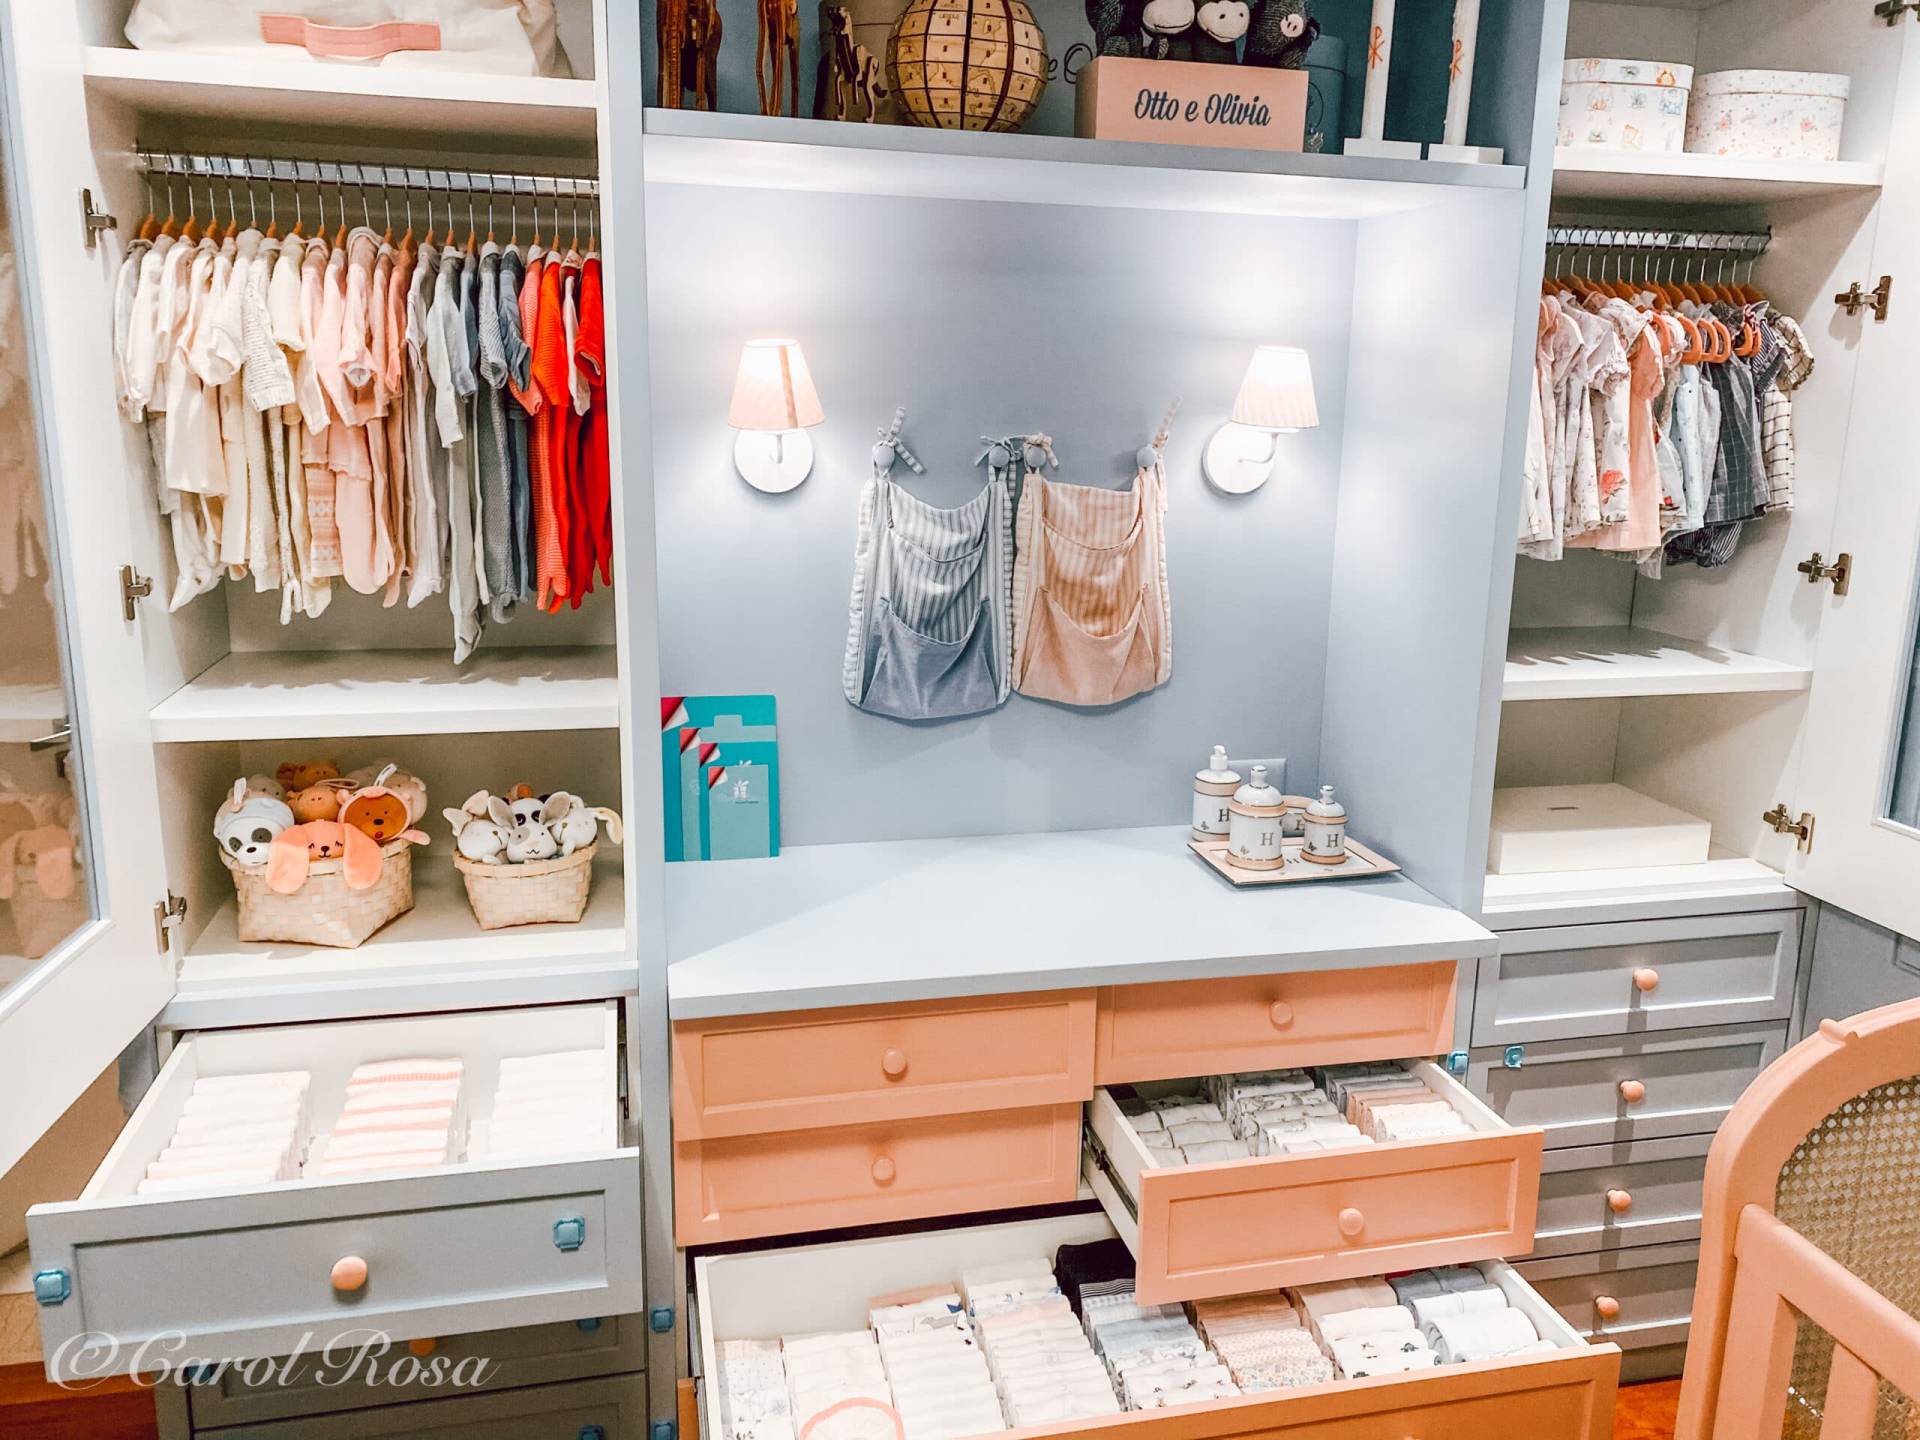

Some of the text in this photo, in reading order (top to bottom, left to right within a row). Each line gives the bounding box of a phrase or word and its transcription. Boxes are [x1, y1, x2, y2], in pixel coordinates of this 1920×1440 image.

[1134, 88, 1271, 127] Otto e Olivia
[1260, 832, 1275, 846] H
[1326, 833, 1339, 848] H
